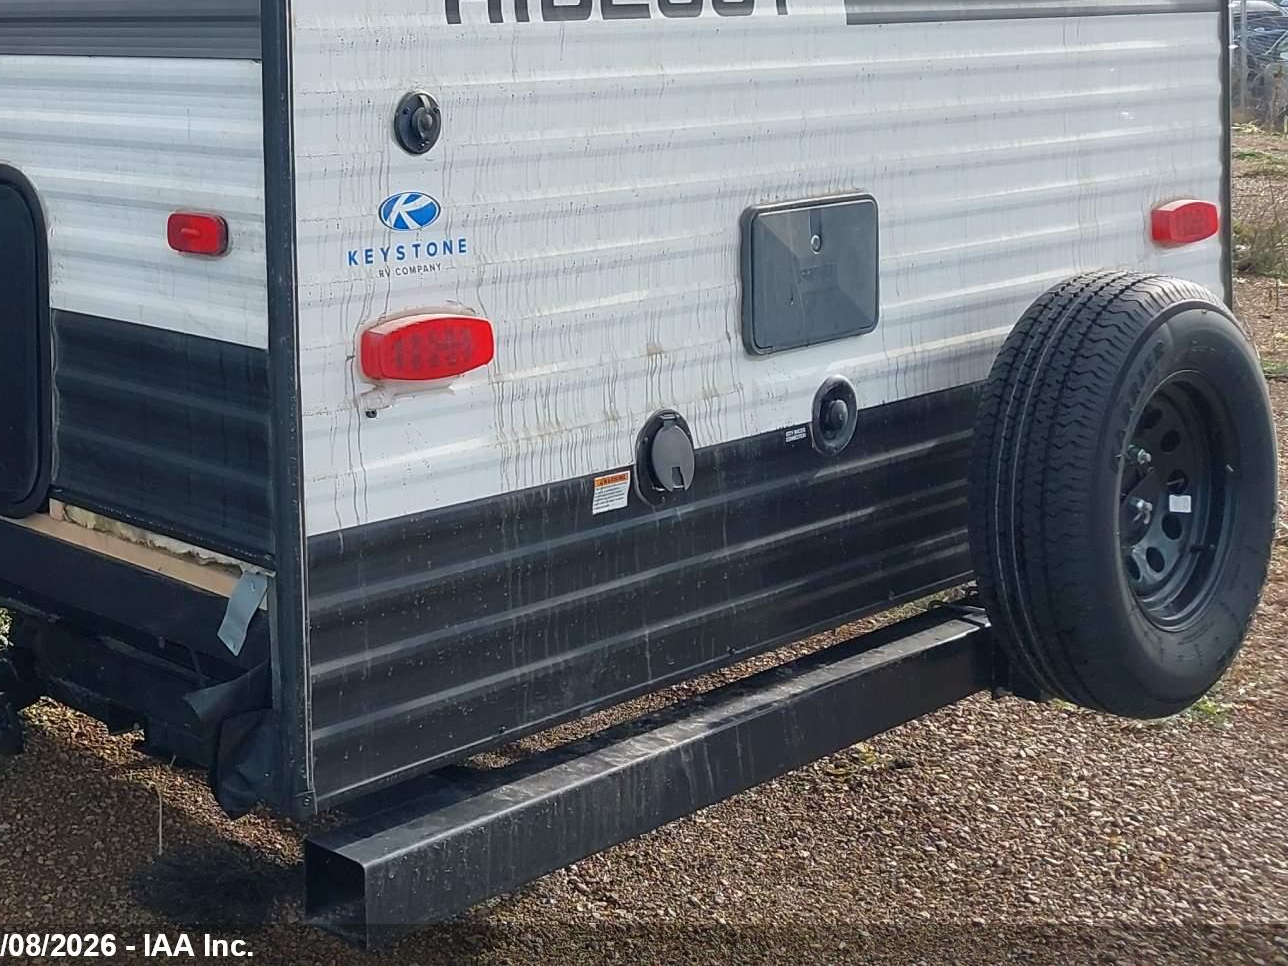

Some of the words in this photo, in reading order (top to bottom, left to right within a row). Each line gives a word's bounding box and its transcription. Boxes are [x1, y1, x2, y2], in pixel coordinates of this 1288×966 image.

[348, 238, 467, 266] KEYSTONE
[379, 266, 391, 278] RV
[395, 263, 441, 276] COMPANY
